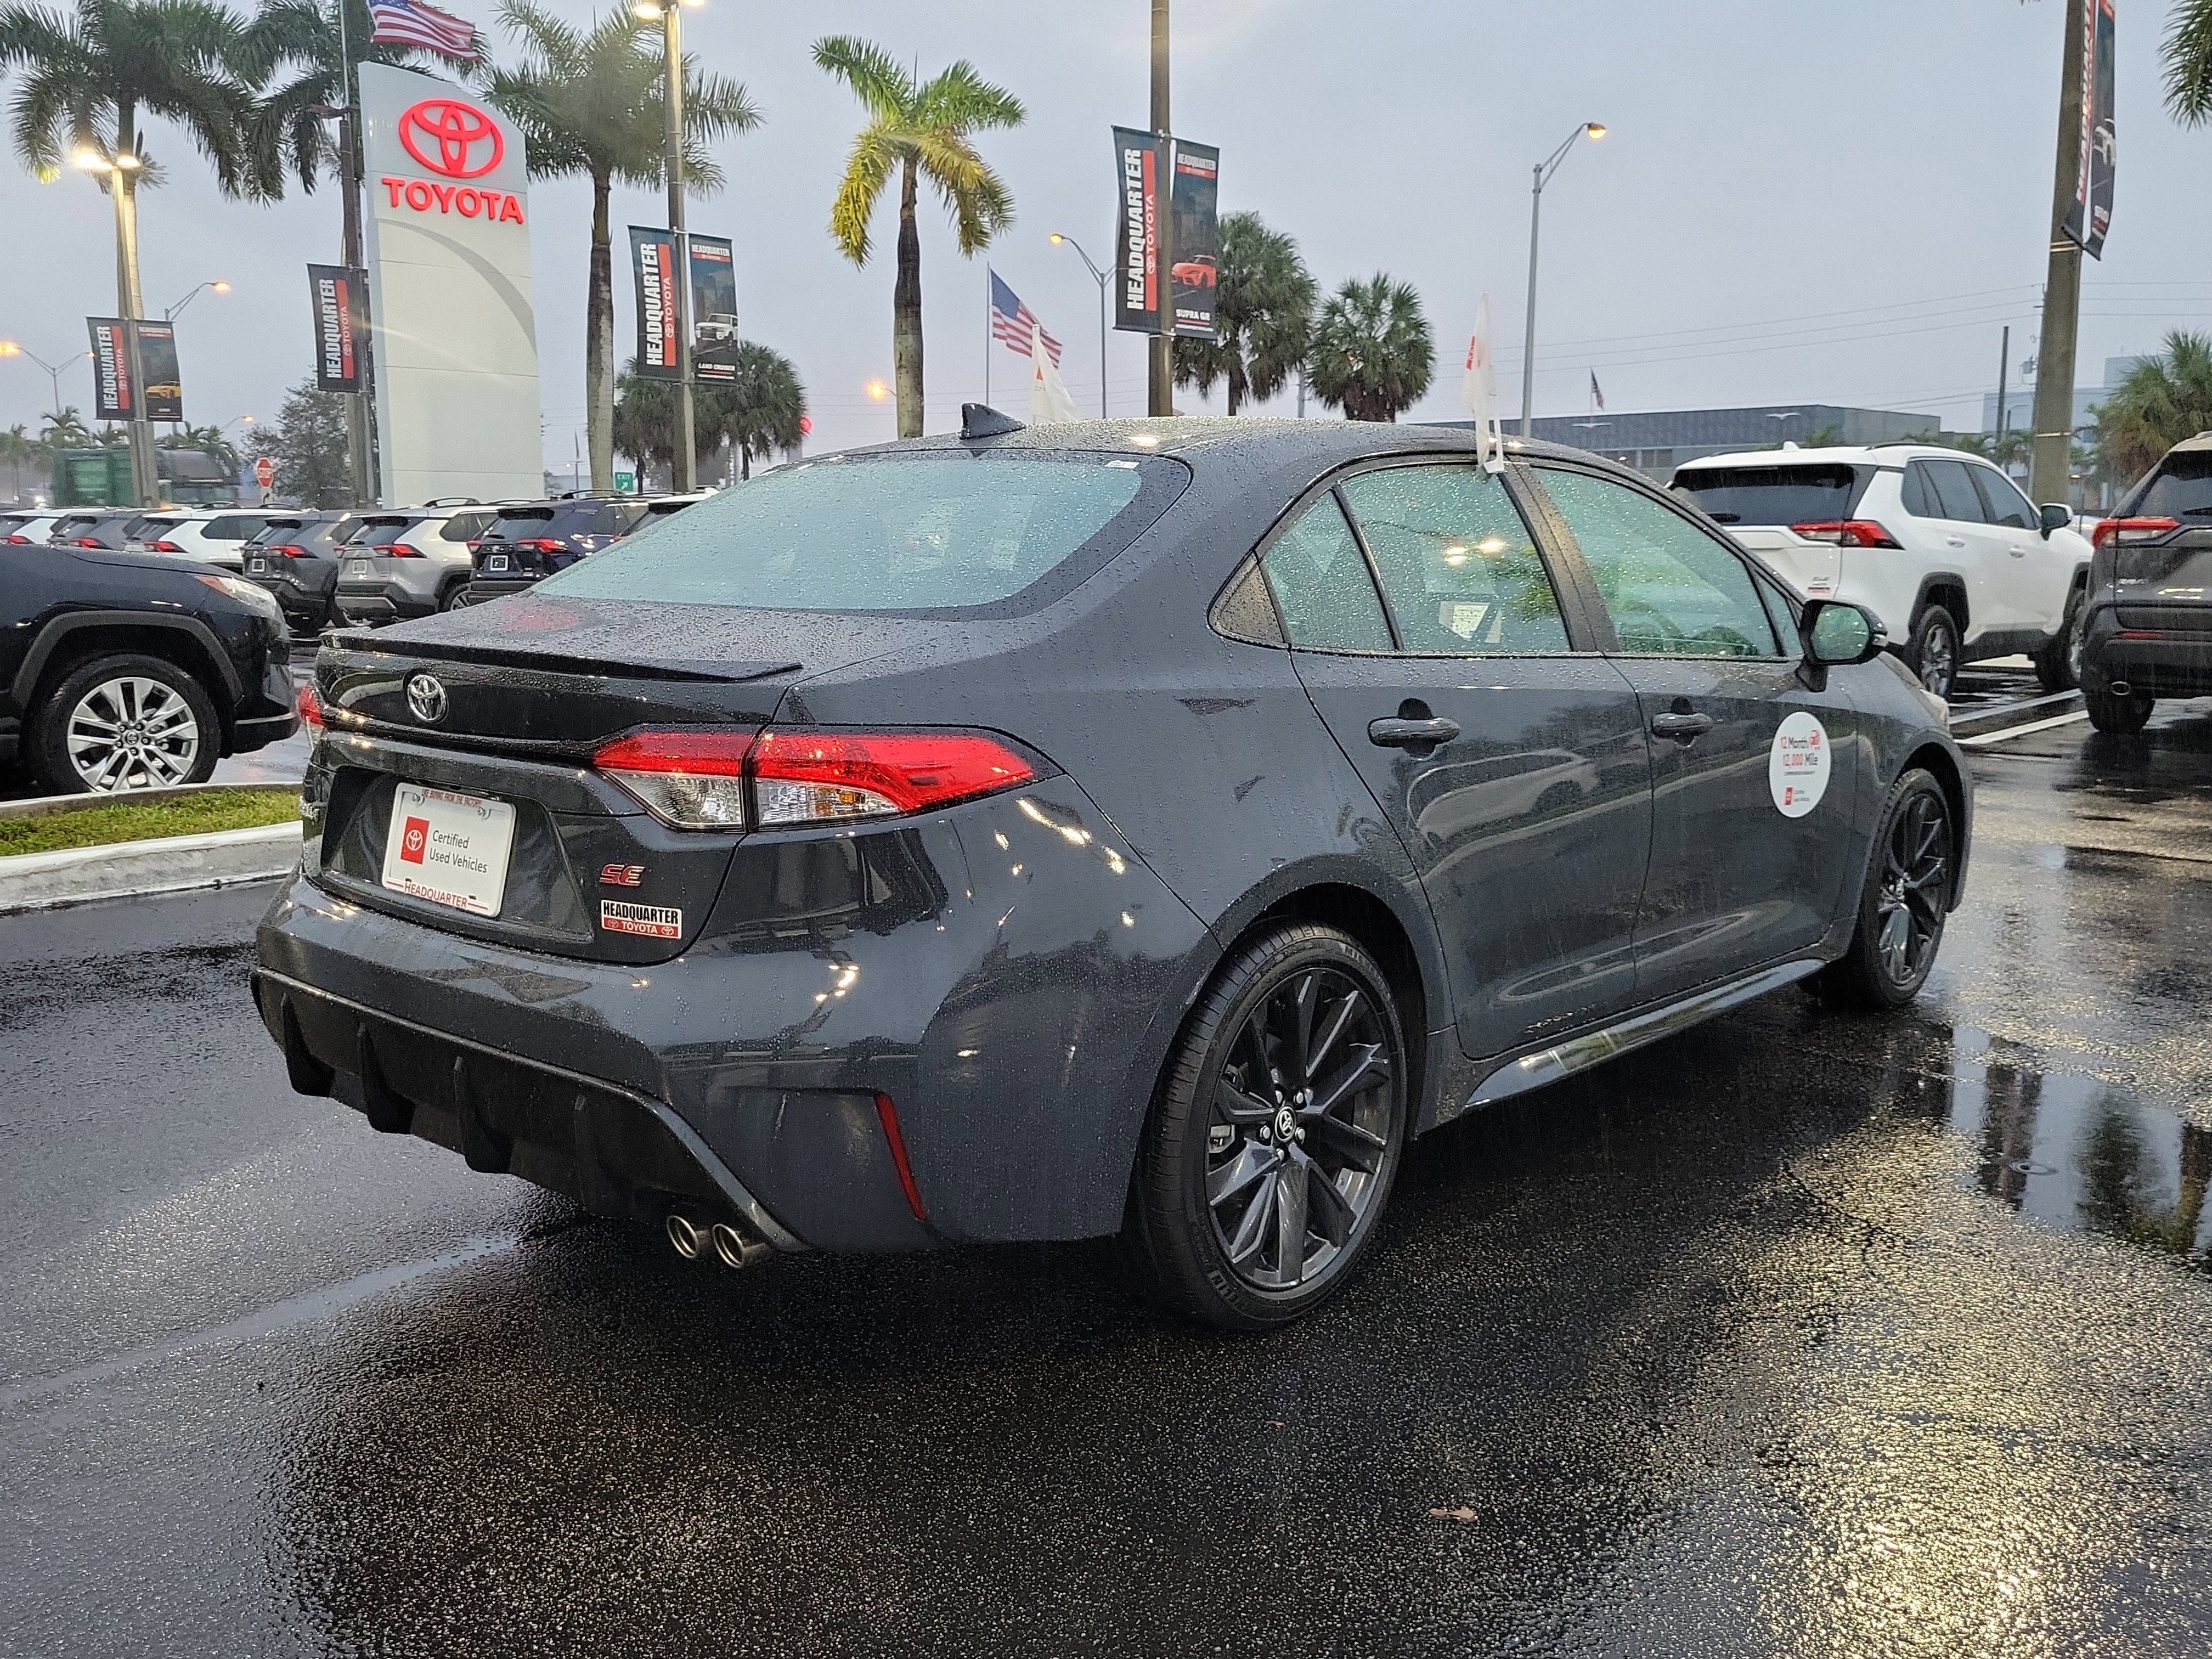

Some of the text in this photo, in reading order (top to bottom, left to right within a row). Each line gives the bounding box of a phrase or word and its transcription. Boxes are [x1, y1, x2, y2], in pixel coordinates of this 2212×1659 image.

[382, 177, 524, 224] TOYOTA
[1124, 148, 1146, 310] HEADQUARTER
[1145, 194, 1155, 252] TOYOTA
[640, 243, 664, 366] HEADQUARTER
[663, 276, 672, 323] TOYOTA
[1176, 309, 1199, 320] SUPRA
[319, 279, 342, 379] HEADQUARTER
[340, 306, 352, 343] TOYOTA
[97, 326, 119, 410] HEADQUARTER
[116, 349, 127, 381] TOYOTA
[259, 467, 272, 478] STOP
[432, 830, 470, 849] Certified
[430, 848, 488, 873] Used Vehicles
[599, 864, 646, 886] SE
[404, 882, 467, 907] HEADQUARTER
[603, 901, 678, 924] HEADQUARTER
[621, 921, 658, 934] TOYOTA
